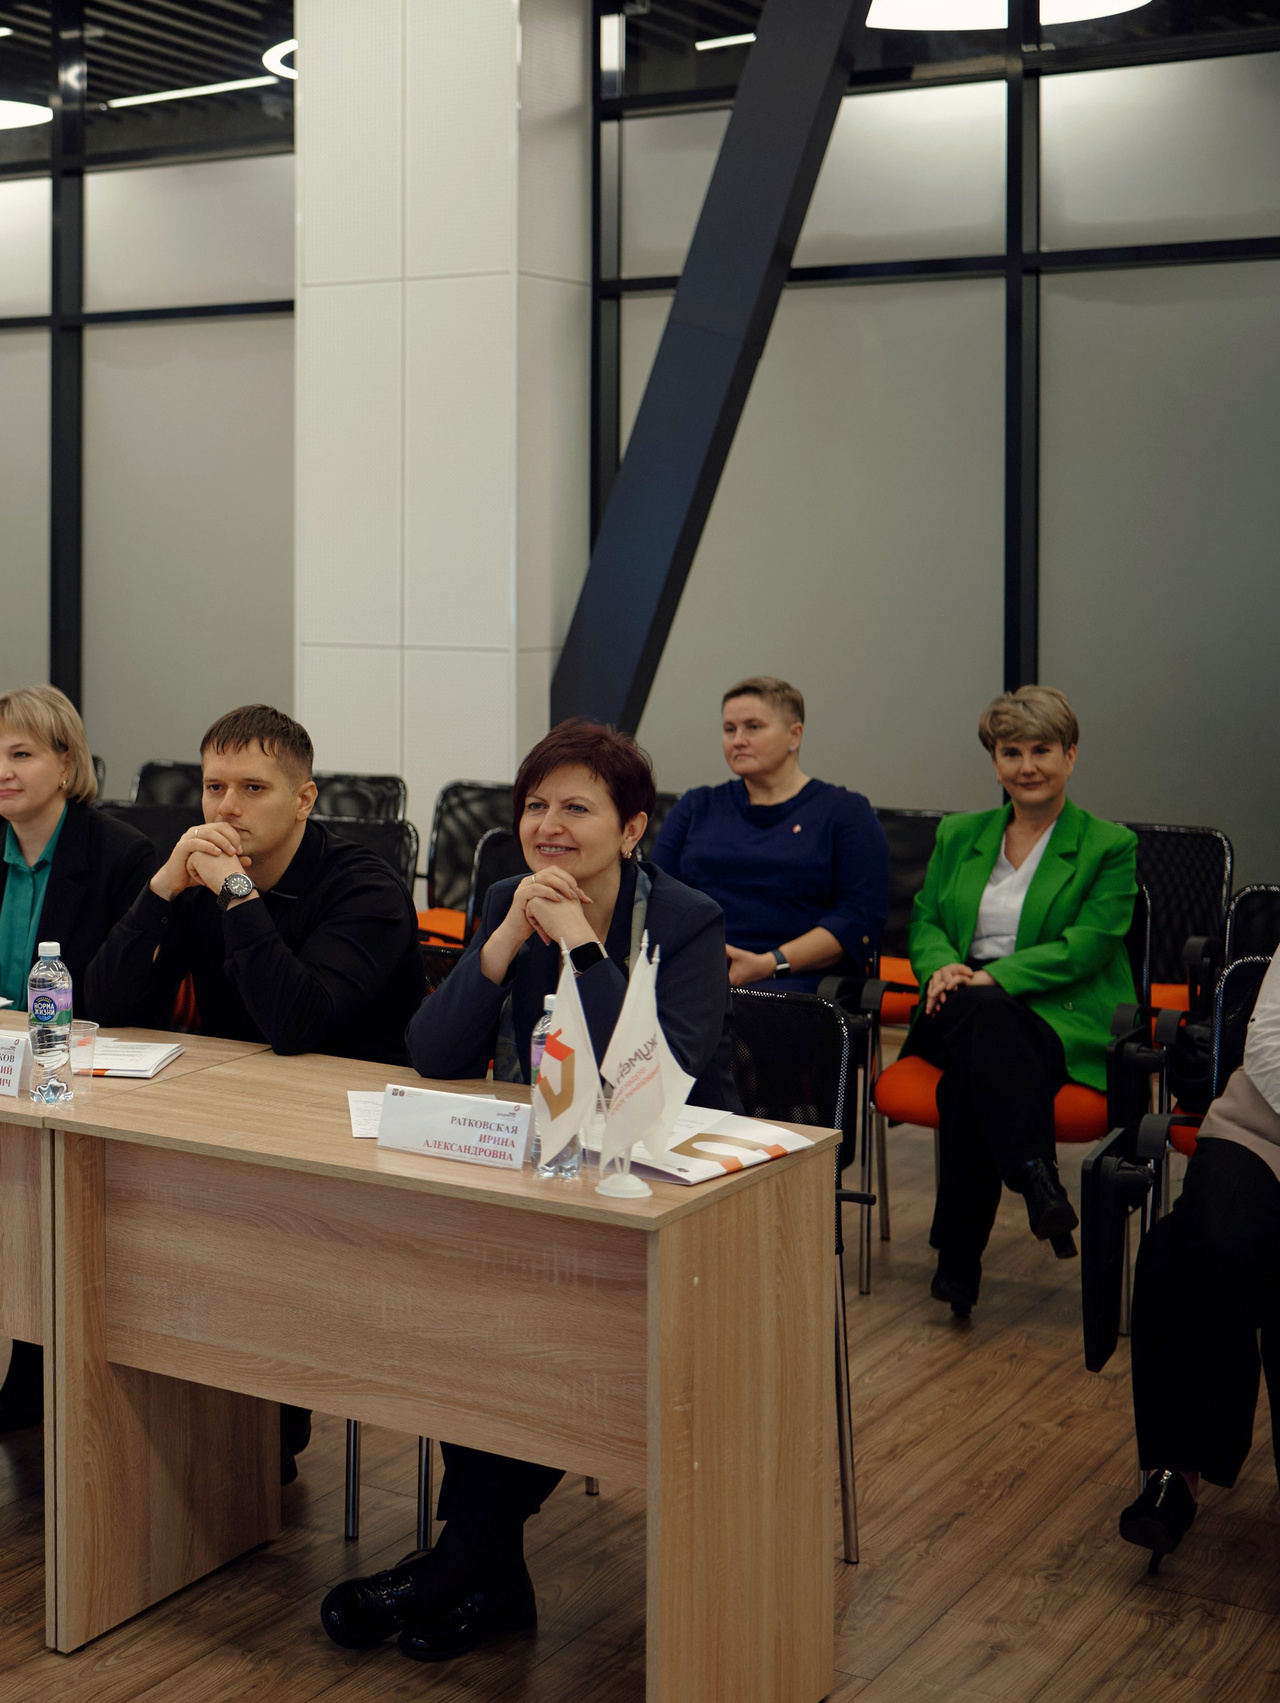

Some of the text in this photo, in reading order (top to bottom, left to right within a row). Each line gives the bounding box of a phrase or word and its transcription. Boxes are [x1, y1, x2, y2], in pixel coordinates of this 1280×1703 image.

[34, 1002, 55, 1010] НОРМА
[450, 1115, 519, 1135] РАТКОВСКАЯ
[478, 1133, 516, 1148] ИРИНА
[423, 1138, 513, 1161] АЛЕКСАНДРОВНА
